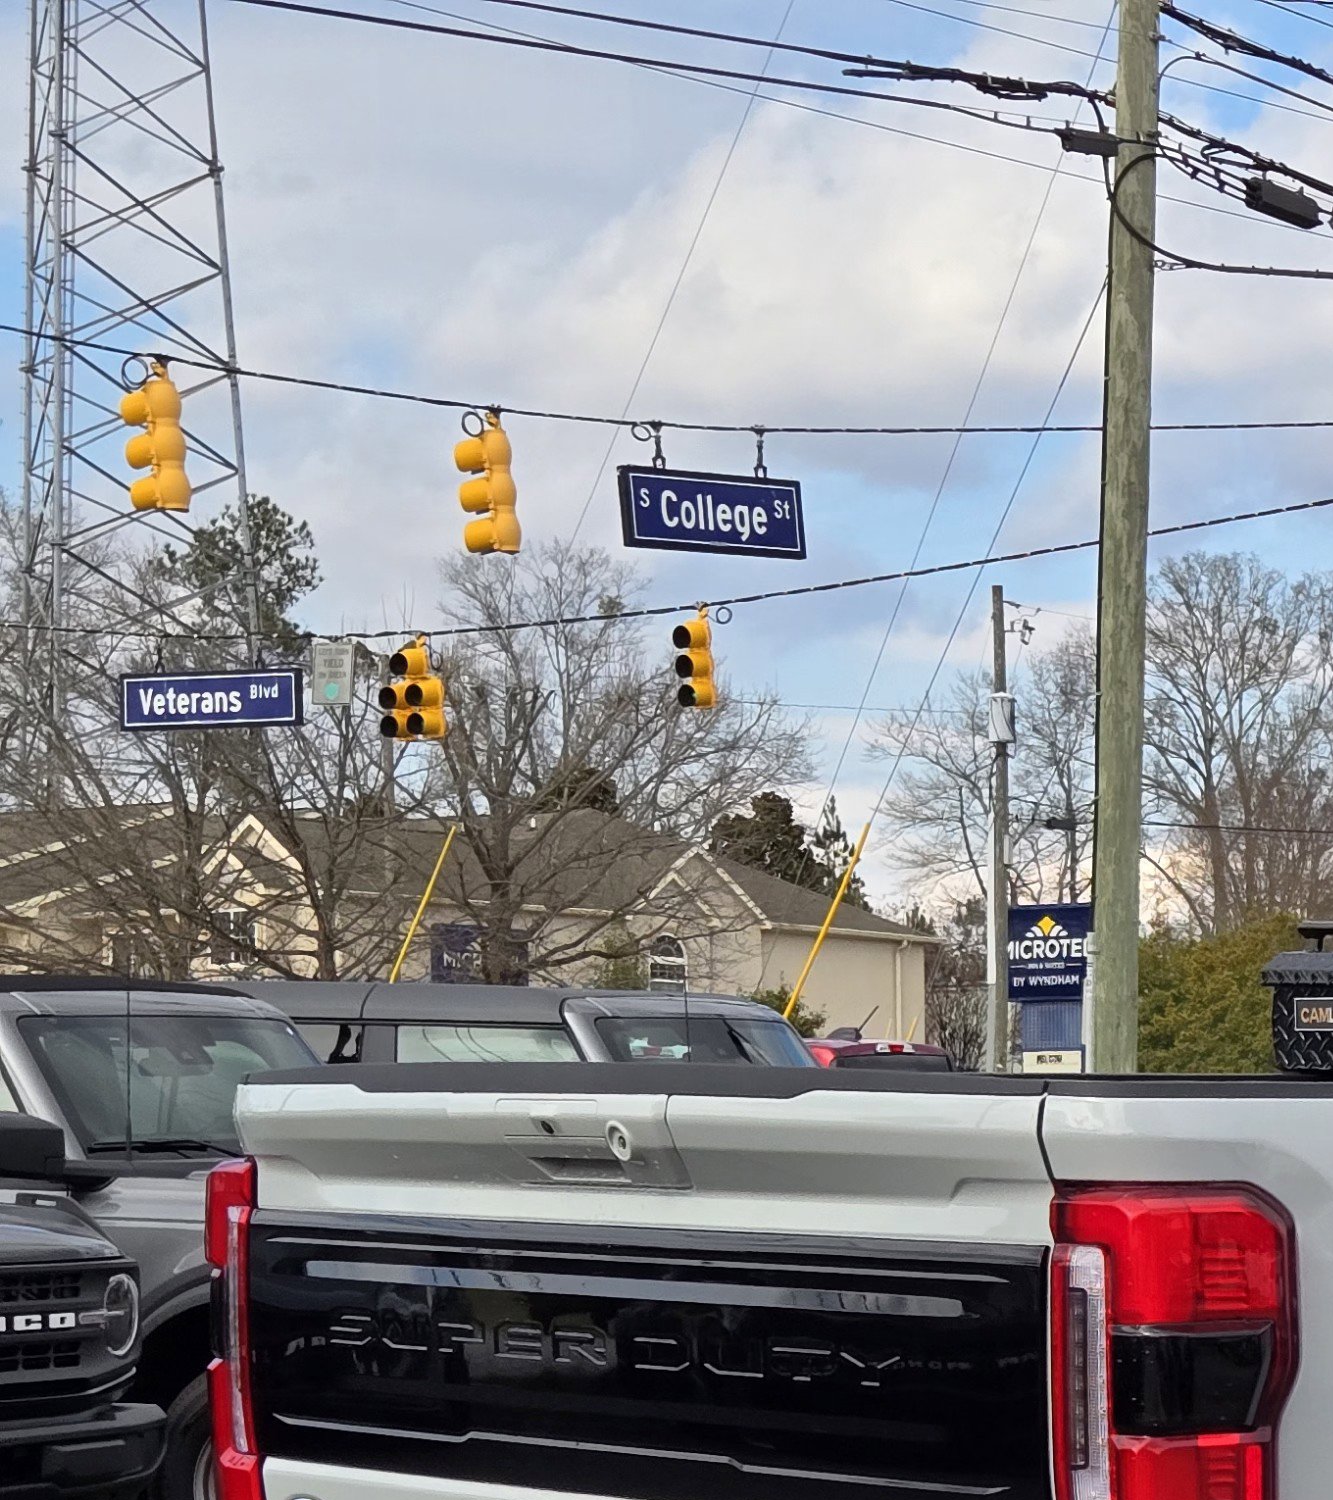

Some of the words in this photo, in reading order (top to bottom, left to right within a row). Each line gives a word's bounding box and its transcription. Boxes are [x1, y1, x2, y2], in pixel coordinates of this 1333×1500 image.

[639, 487, 650, 508] S
[661, 489, 768, 542] College
[773, 499, 791, 520] St
[138, 686, 242, 716] Veterans
[249, 682, 279, 700] Blvd
[1012, 976, 1026, 988] BY
[1028, 974, 1081, 987] WYNDHAM
[0, 1312, 76, 1332] CO
[328, 1313, 608, 1366] SUPER
[632, 1335, 902, 1388] DUTY
